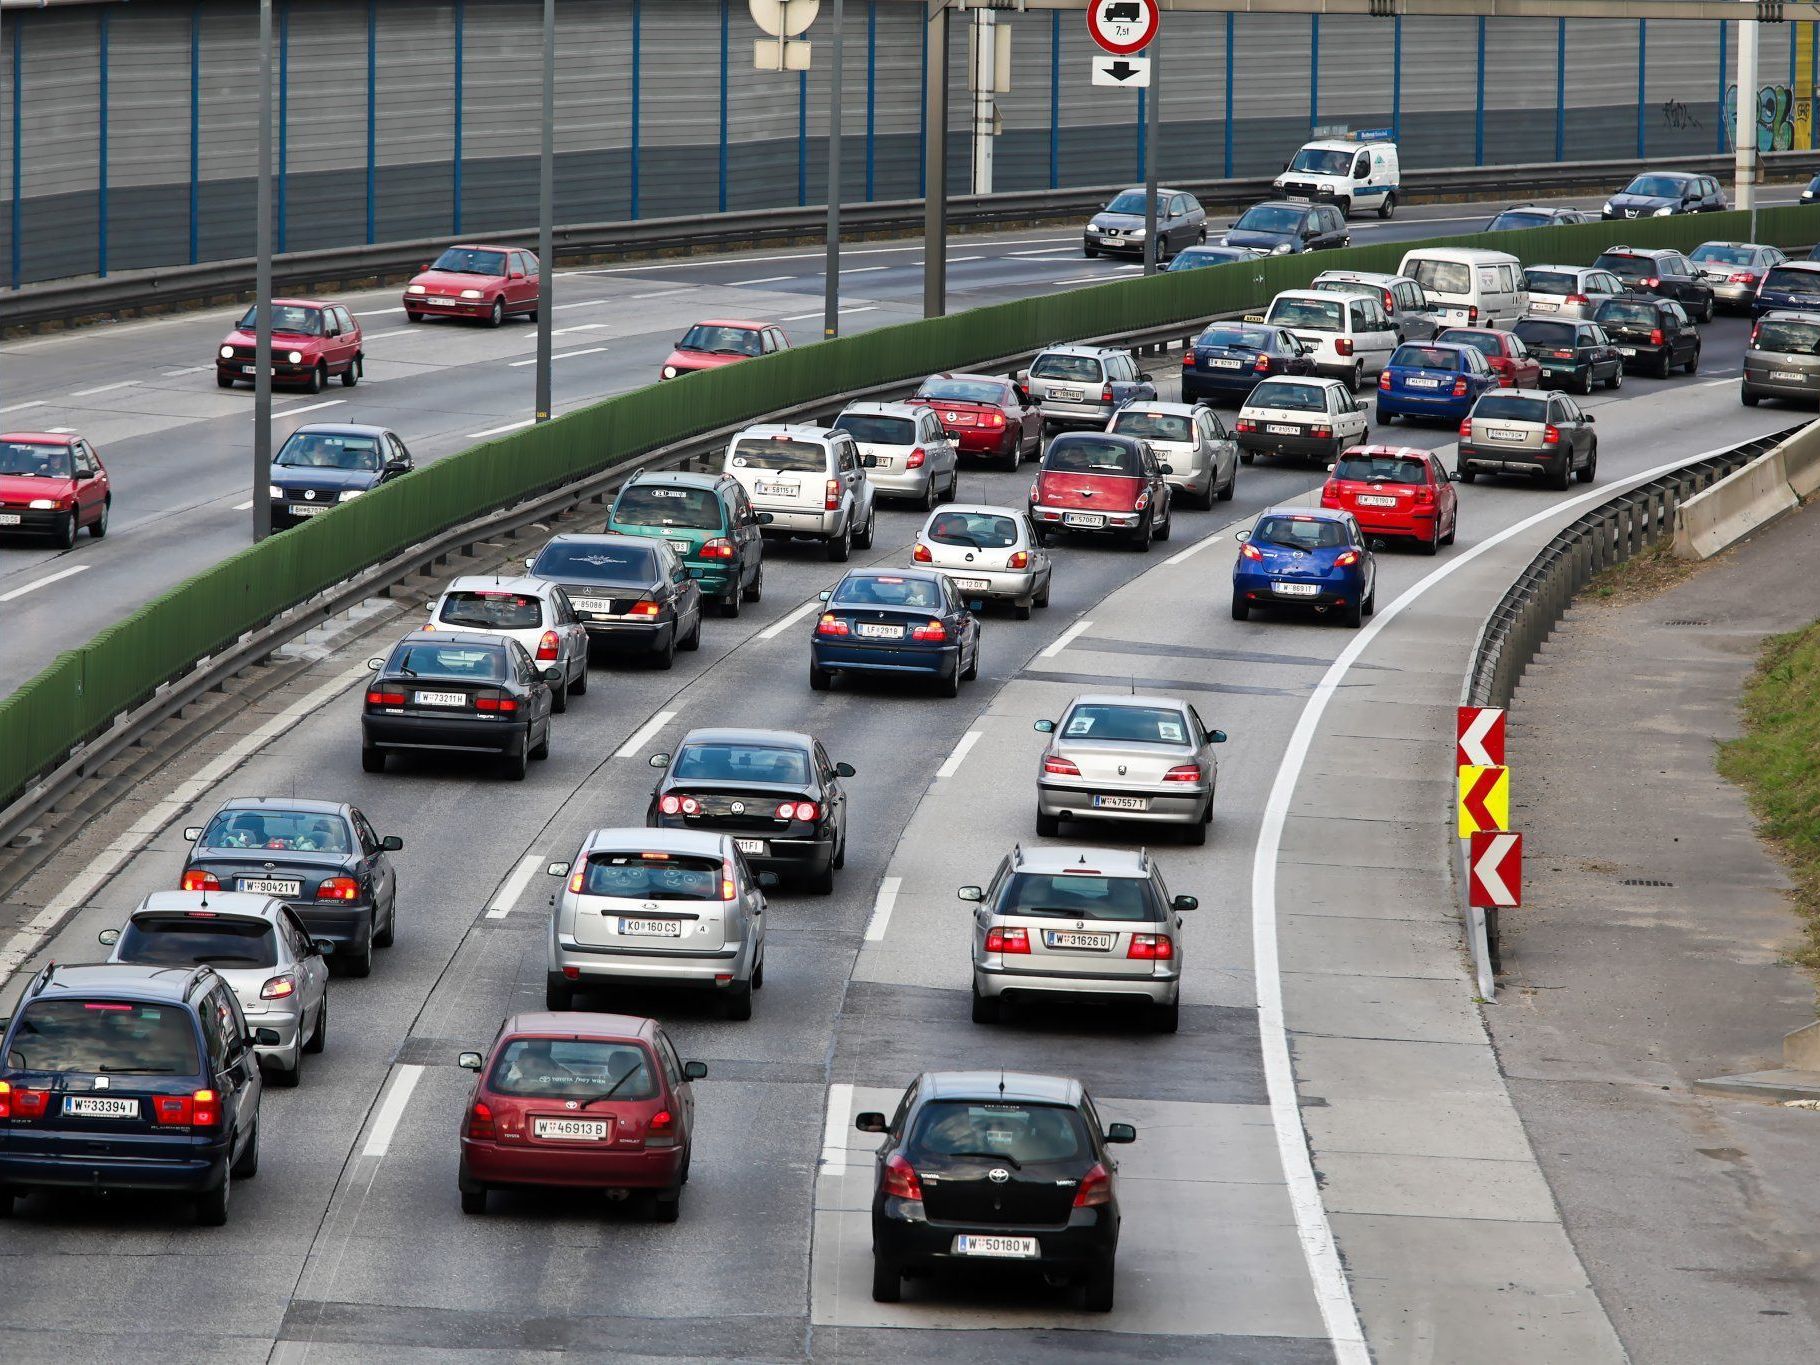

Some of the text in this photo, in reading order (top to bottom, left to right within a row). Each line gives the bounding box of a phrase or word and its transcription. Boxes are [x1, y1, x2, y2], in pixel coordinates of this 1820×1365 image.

[422, 693, 429, 701] W
[1100, 796, 1107, 805] W
[1111, 797, 1137, 808] 47557
[246, 881, 253, 891] W
[260, 882, 288, 893] 90421
[1056, 934, 1064, 944] W
[1070, 935, 1099, 947] 31626
[75, 1100, 82, 1111] W
[91, 1100, 126, 1113] 33394
[539, 1122, 603, 1135] W 46913 B
[969, 1238, 1031, 1252] W 50180 W
